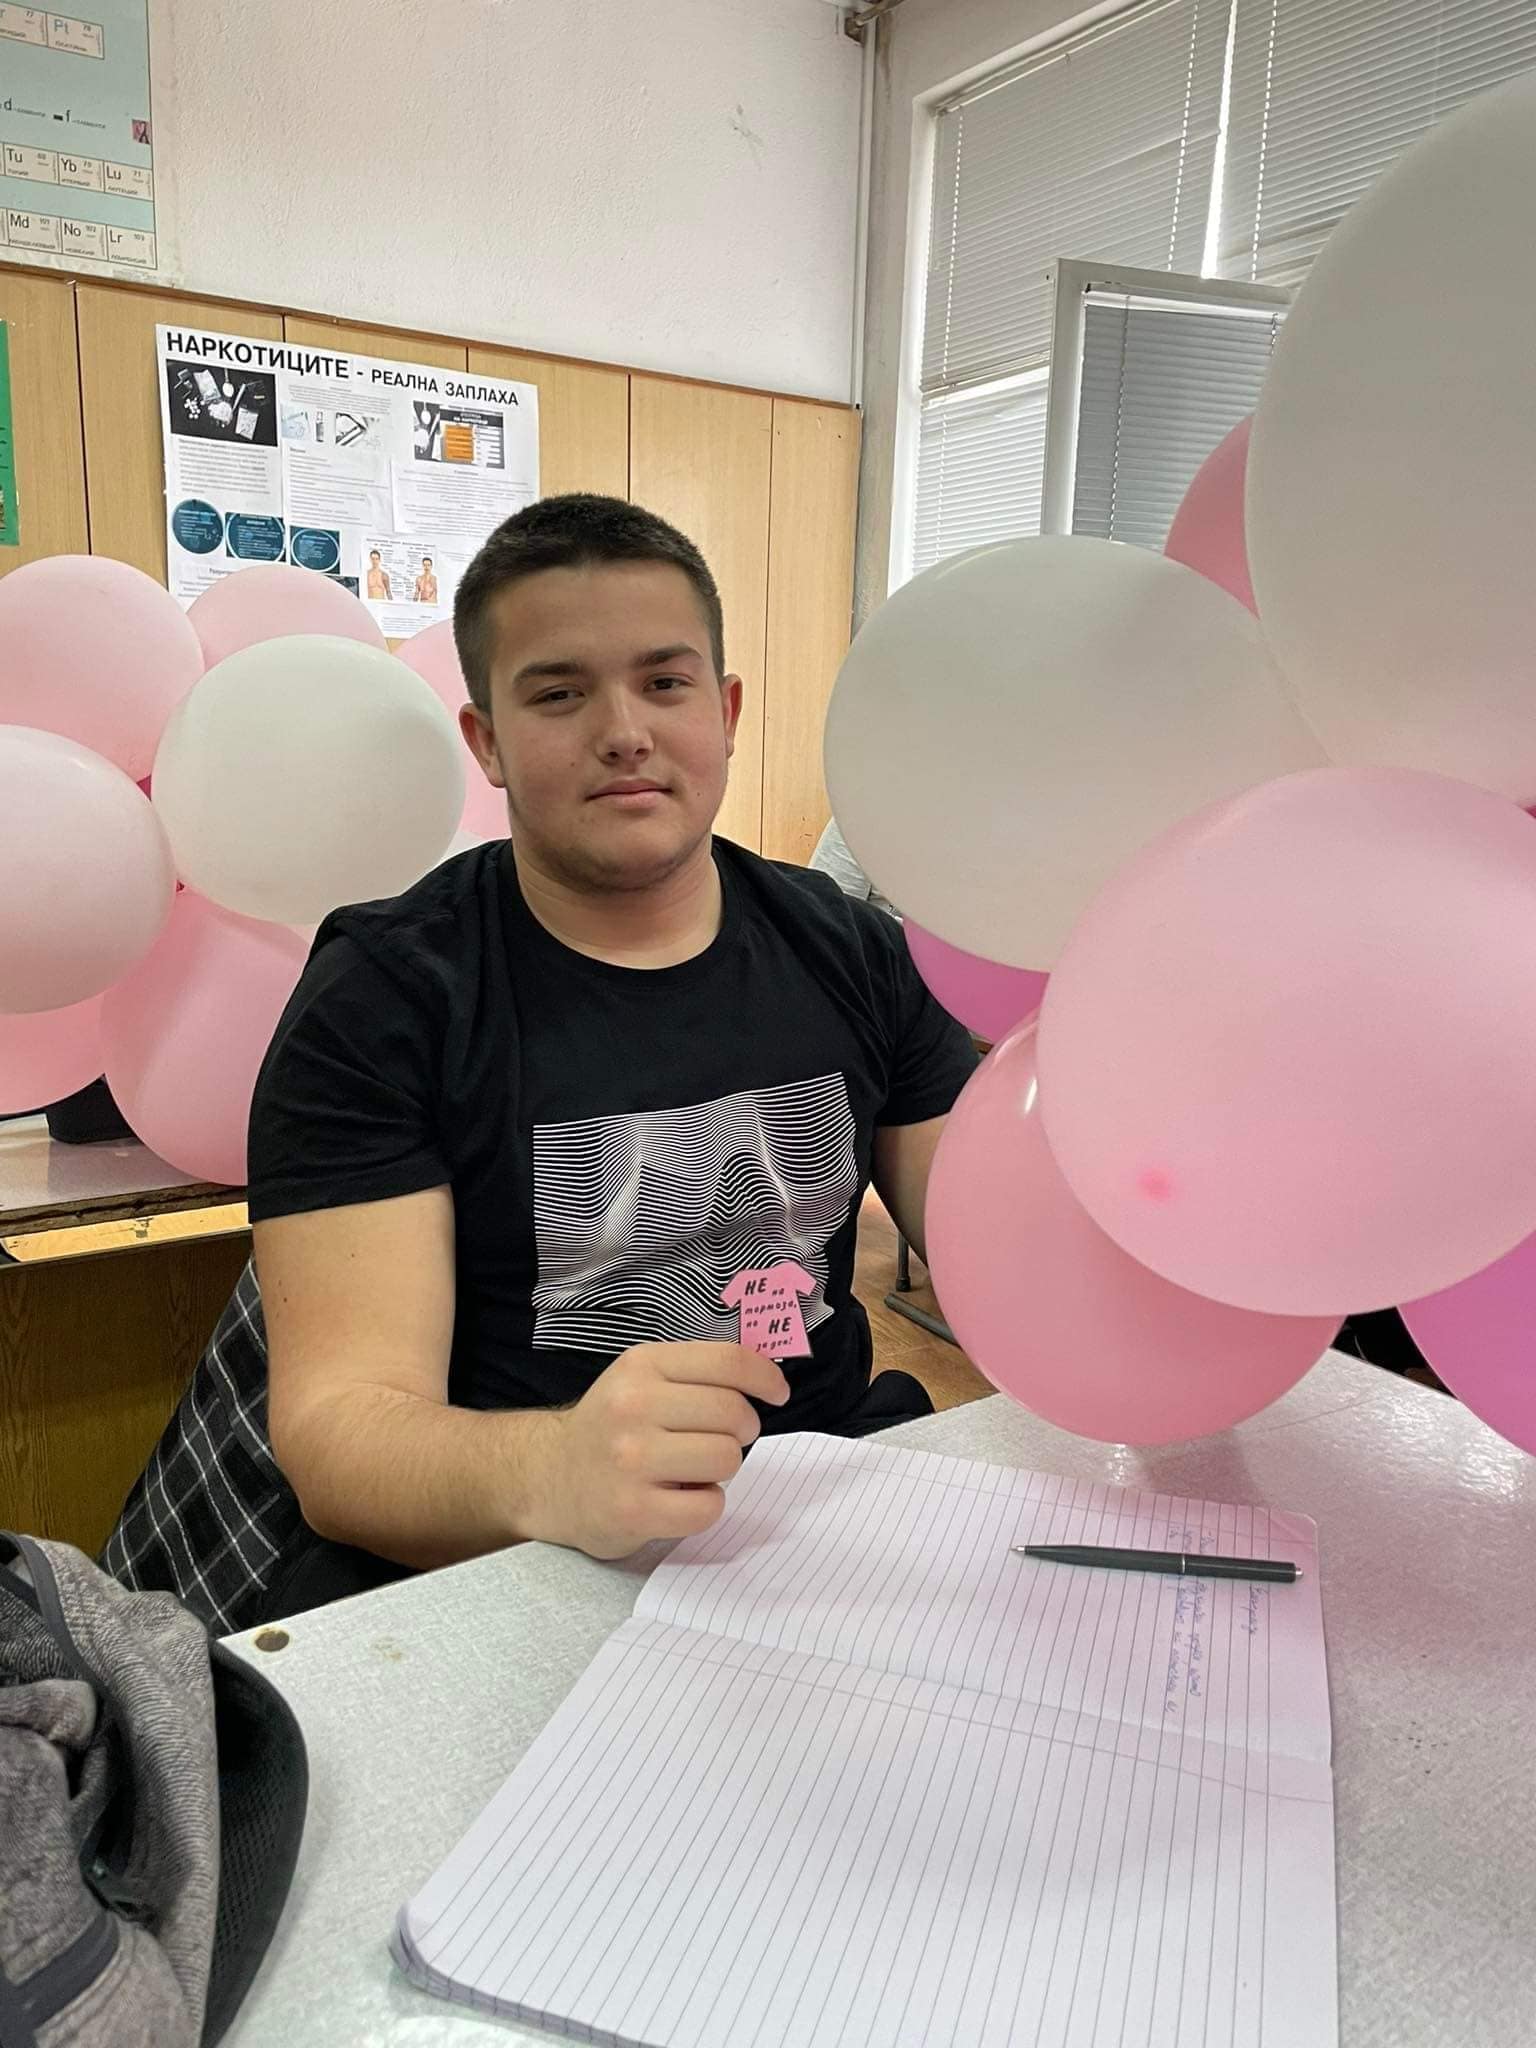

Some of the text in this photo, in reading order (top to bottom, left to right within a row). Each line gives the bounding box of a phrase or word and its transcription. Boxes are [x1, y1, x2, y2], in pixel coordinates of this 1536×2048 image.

[54, 19, 69, 35] Pt
[7, 148, 23, 163] Tu
[61, 158, 77, 173] Yb
[106, 165, 122, 180] Lu
[10, 213, 30, 229] Md
[63, 222, 82, 237] No
[109, 230, 123, 243] Lr
[166, 331, 350, 379] НАРКОТИЦИТЕ
[371, 368, 439, 393] РЕАЛНА
[445, 381, 520, 406] ЗАПЛАХА
[744, 1277, 768, 1296] НЕ
[768, 1316, 792, 1335] НЕ
